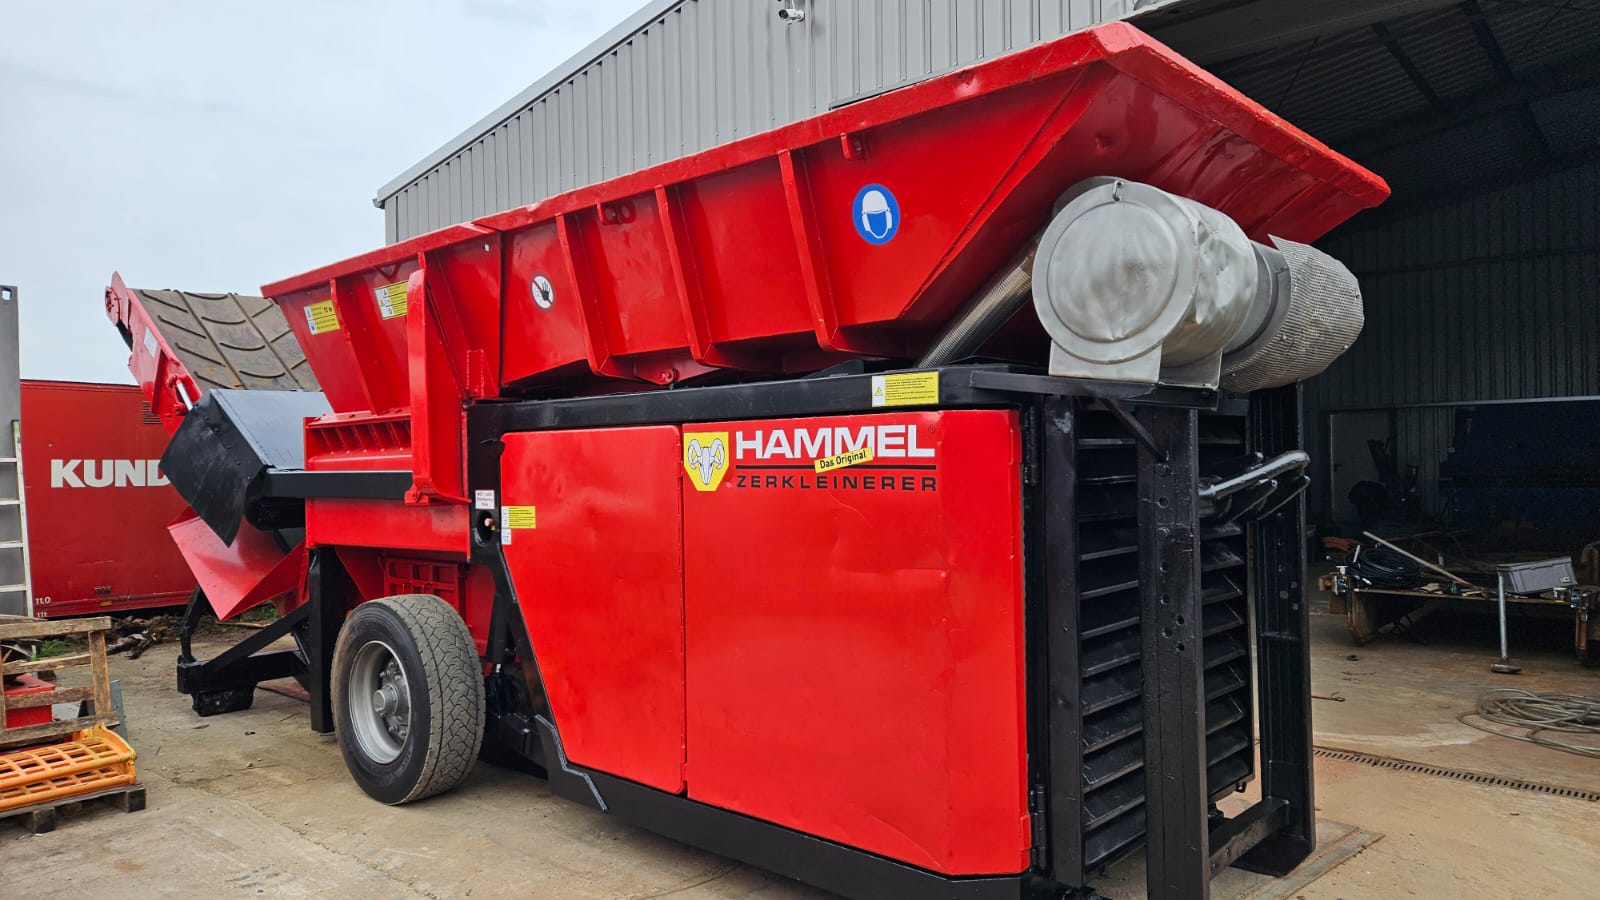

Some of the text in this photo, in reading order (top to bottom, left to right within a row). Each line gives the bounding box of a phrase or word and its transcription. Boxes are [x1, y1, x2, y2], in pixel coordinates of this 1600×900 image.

[736, 425, 935, 459] HAMMEL
[820, 450, 866, 469] Das Original
[737, 475, 937, 491] ZERKLEINERER
